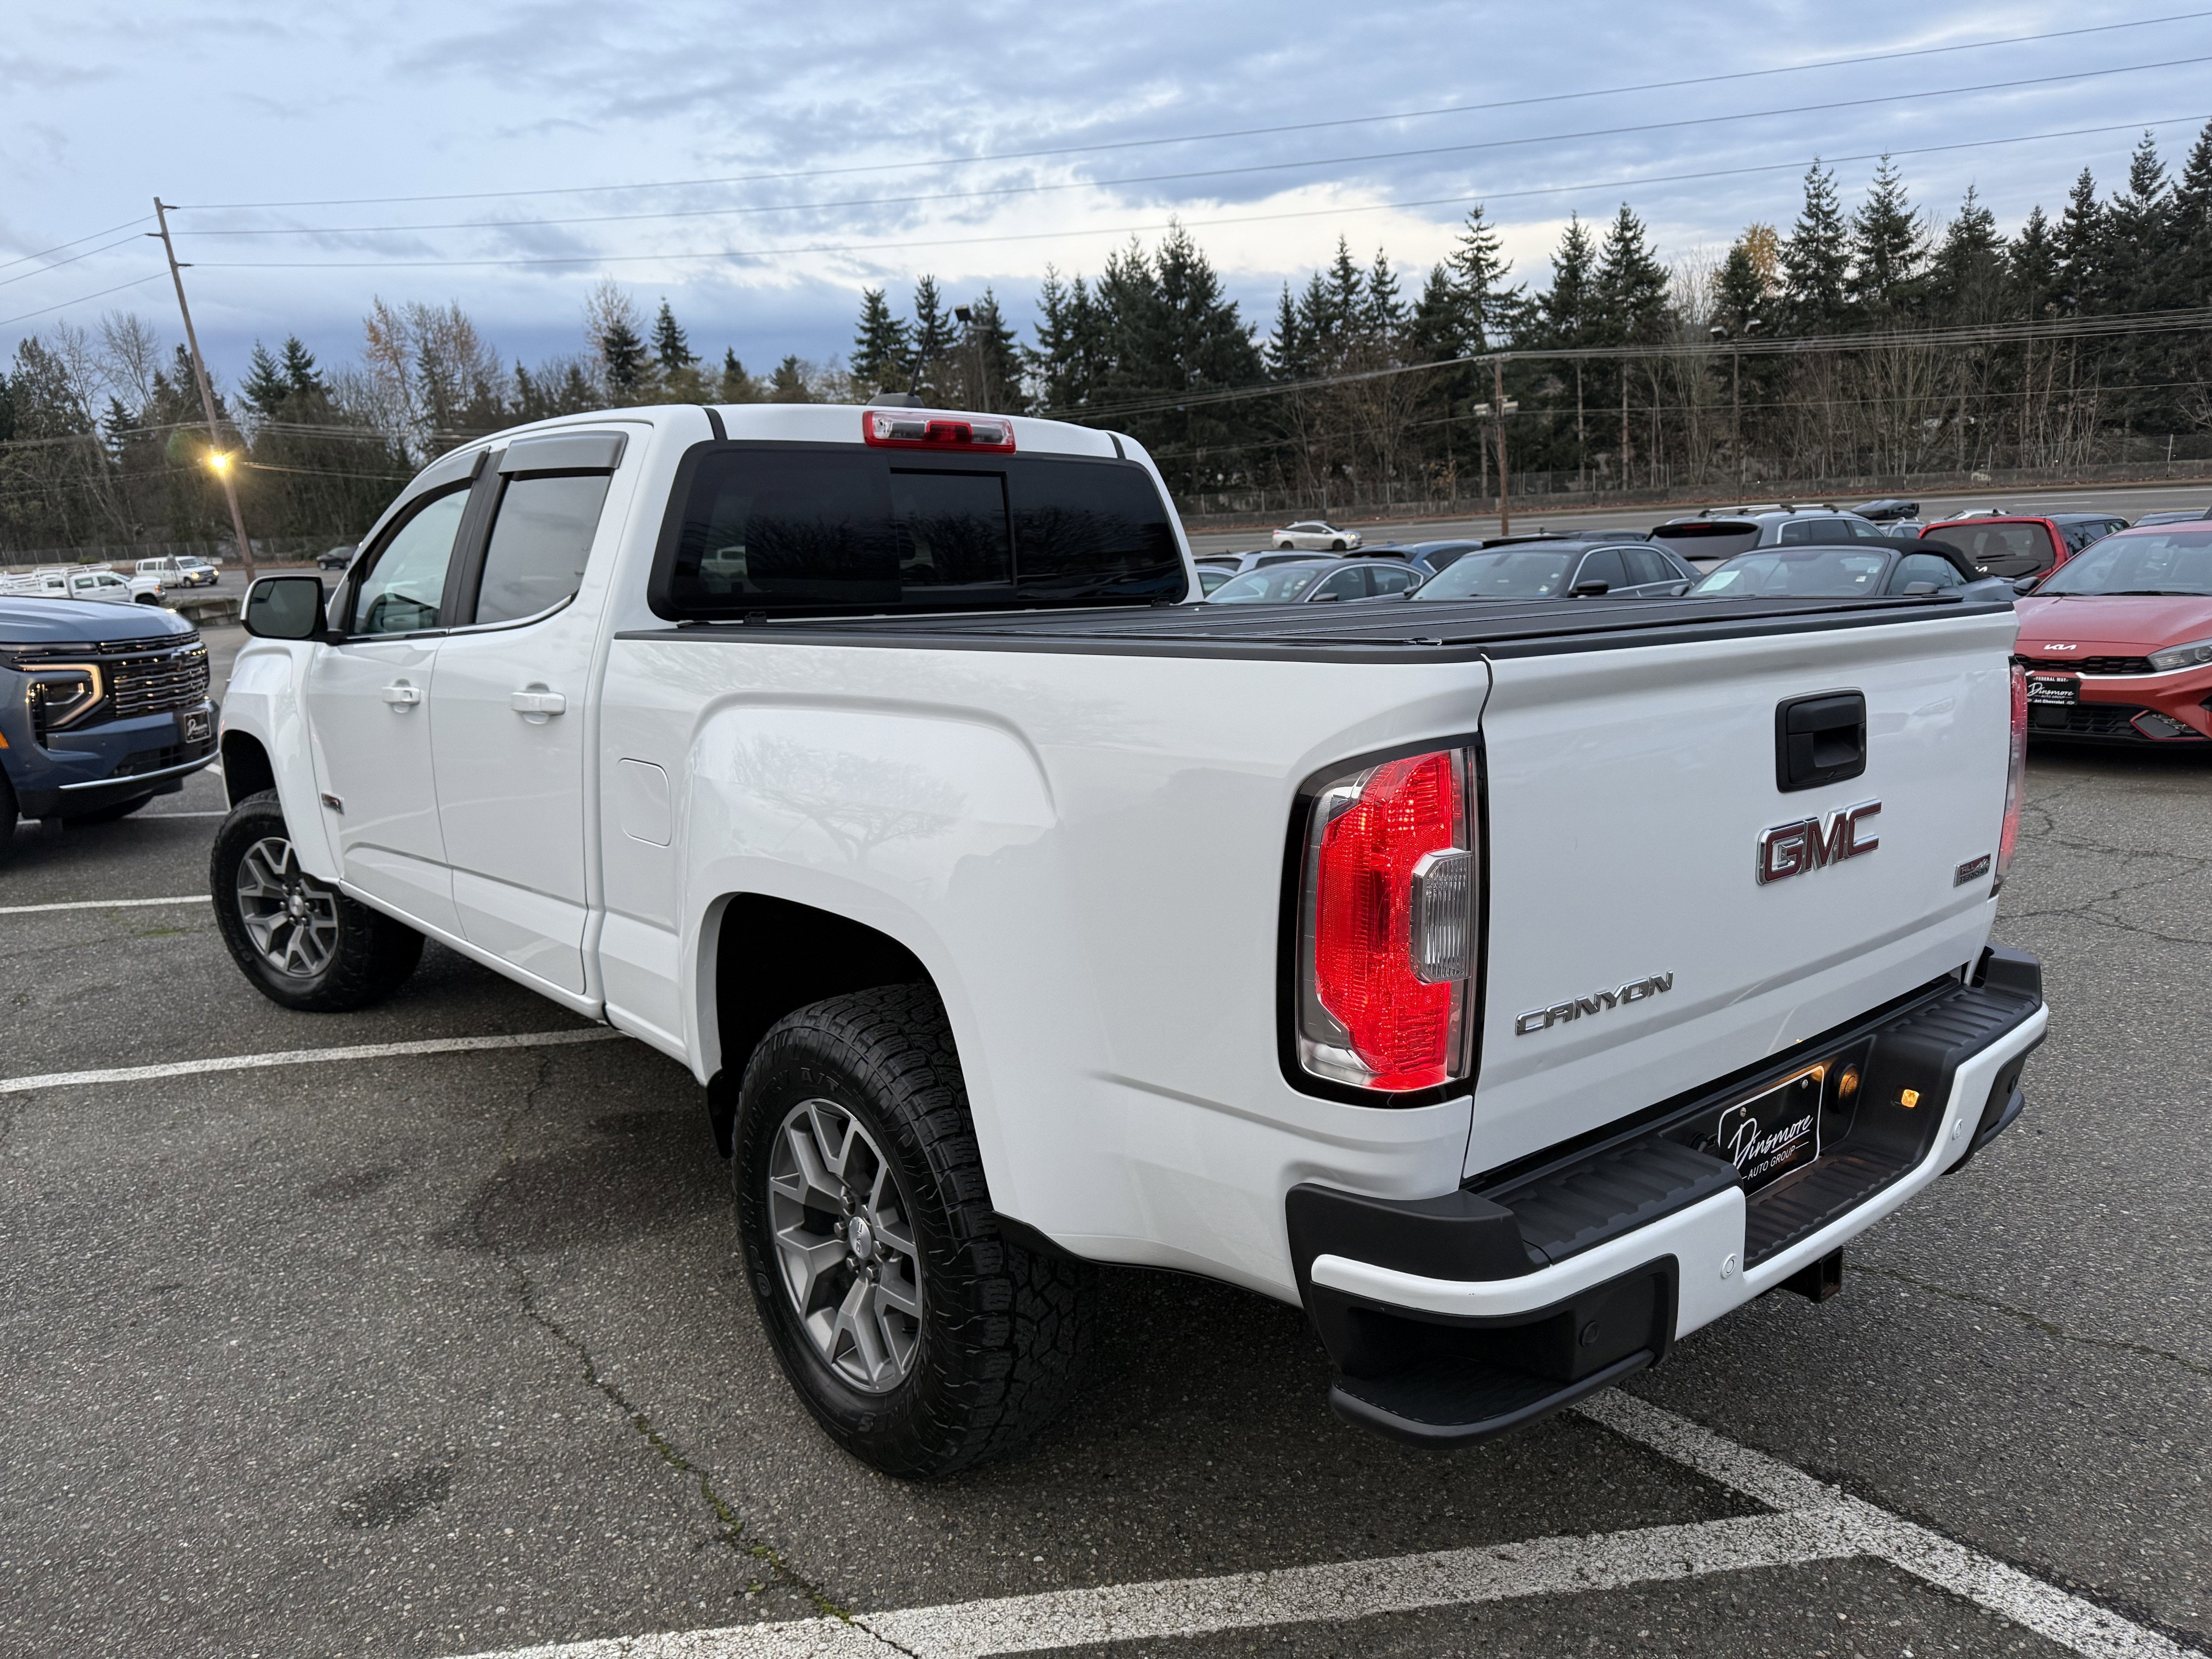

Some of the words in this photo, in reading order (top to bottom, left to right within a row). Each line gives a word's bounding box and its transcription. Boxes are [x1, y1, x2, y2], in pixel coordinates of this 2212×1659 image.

[2027, 682, 2074, 697] Dinsmore
[1755, 799, 1882, 886] GMC
[1960, 866, 1989, 883] TERRAIN
[1961, 863, 1975, 874] ALL
[1515, 970, 1673, 1036] CANYON
[1728, 1115, 1814, 1170] Dinsmore
[1747, 1160, 1769, 1180] AUTO
[1770, 1145, 1795, 1167] GROUP
